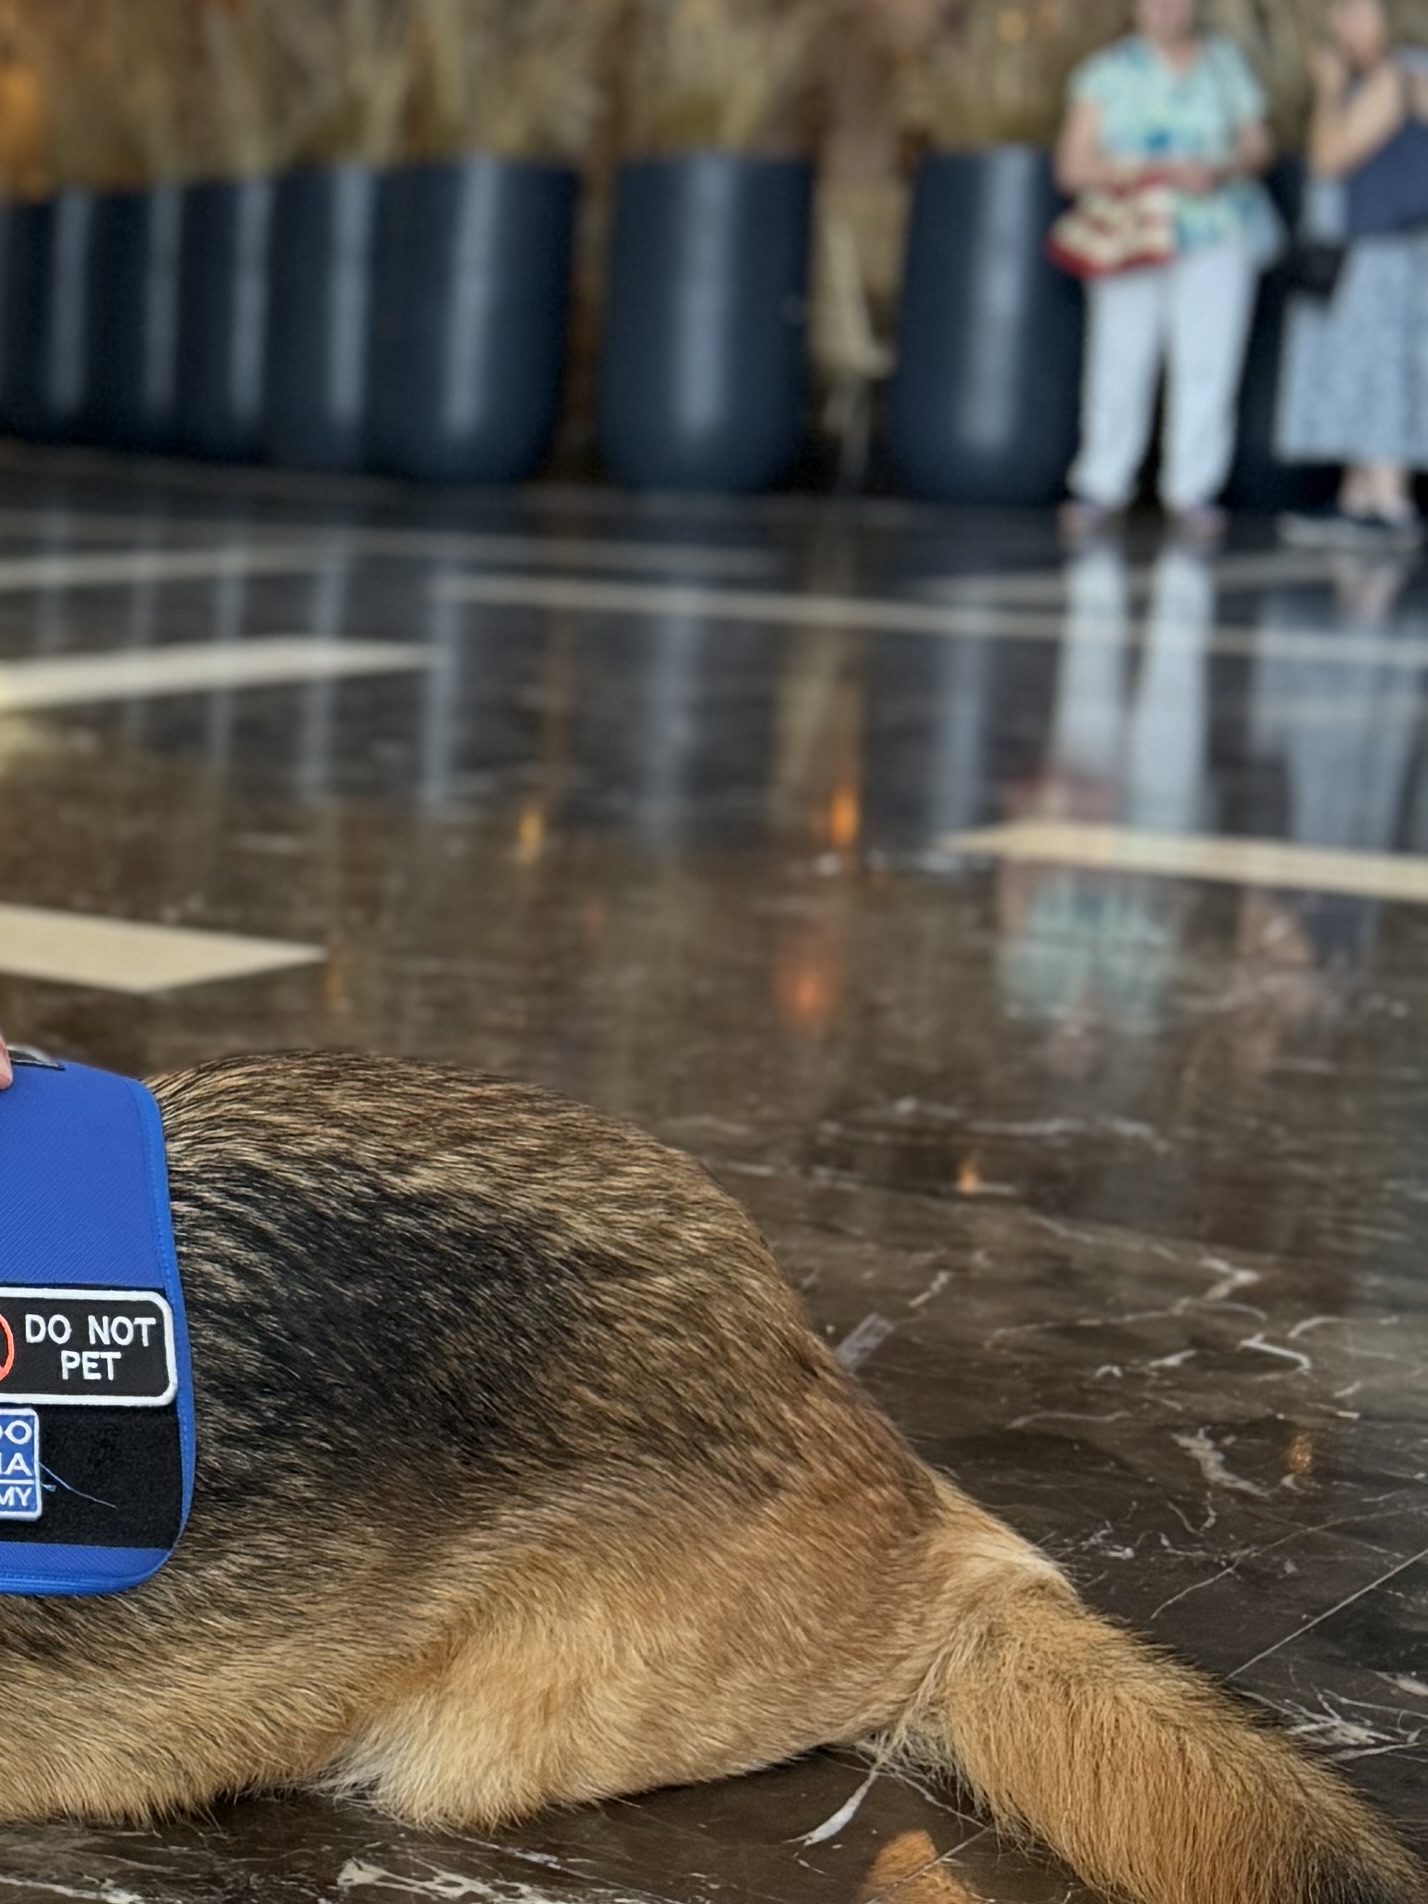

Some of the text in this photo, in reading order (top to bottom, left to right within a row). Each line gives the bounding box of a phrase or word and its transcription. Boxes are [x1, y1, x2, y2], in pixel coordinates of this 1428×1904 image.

[25, 1313, 156, 1347] DO NOT
[61, 1349, 121, 1381] PET
